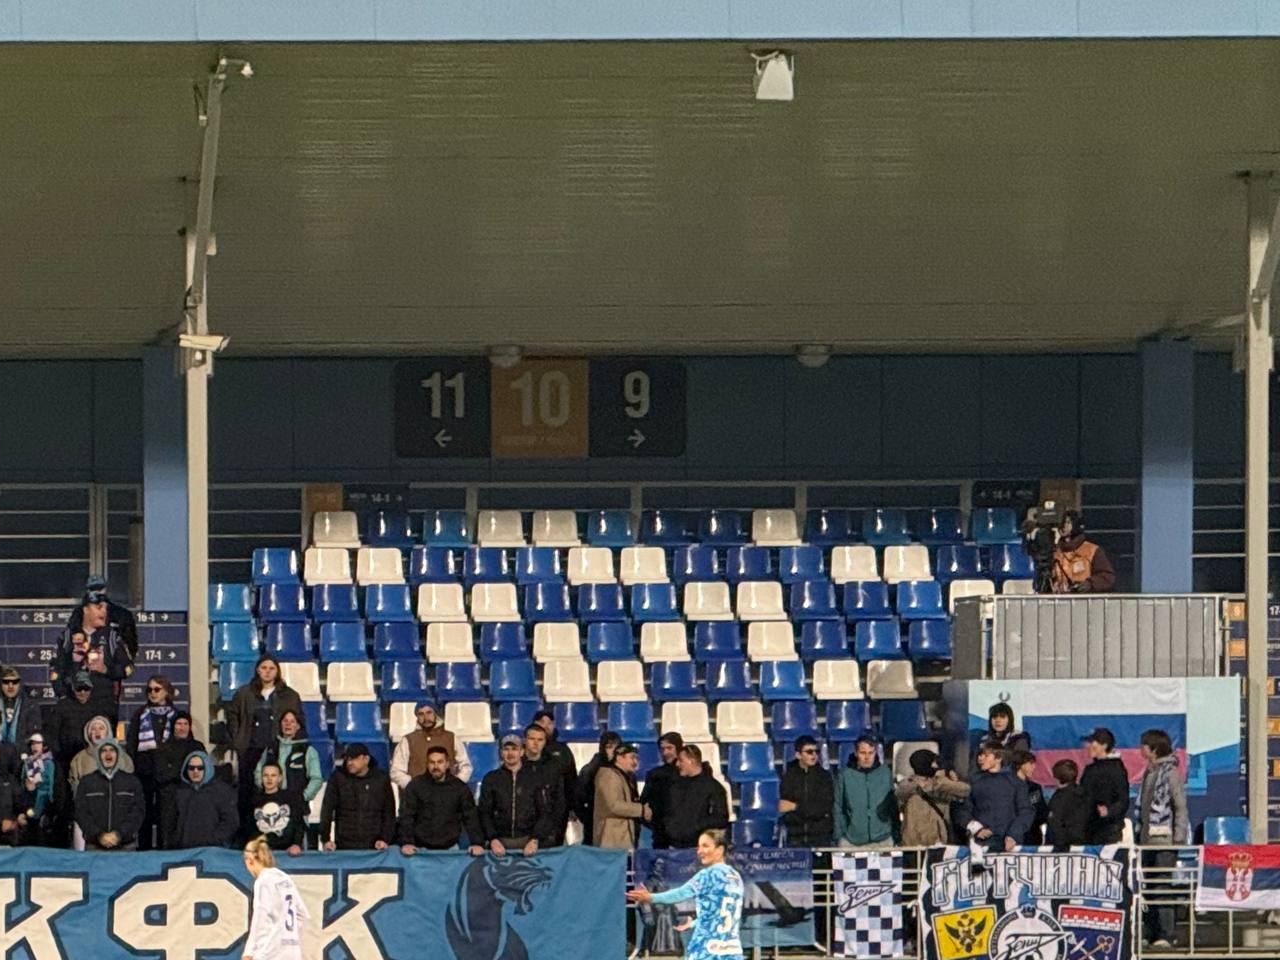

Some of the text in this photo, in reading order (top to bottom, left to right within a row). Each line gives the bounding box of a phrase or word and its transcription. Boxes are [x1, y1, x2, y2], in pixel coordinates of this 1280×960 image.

[421, 371, 464, 418] 11
[511, 370, 570, 428] 10
[624, 371, 651, 418] 9
[33, 612, 54, 623] 25-1
[40, 650, 57, 661] 25-
[144, 650, 162, 661] 17-1
